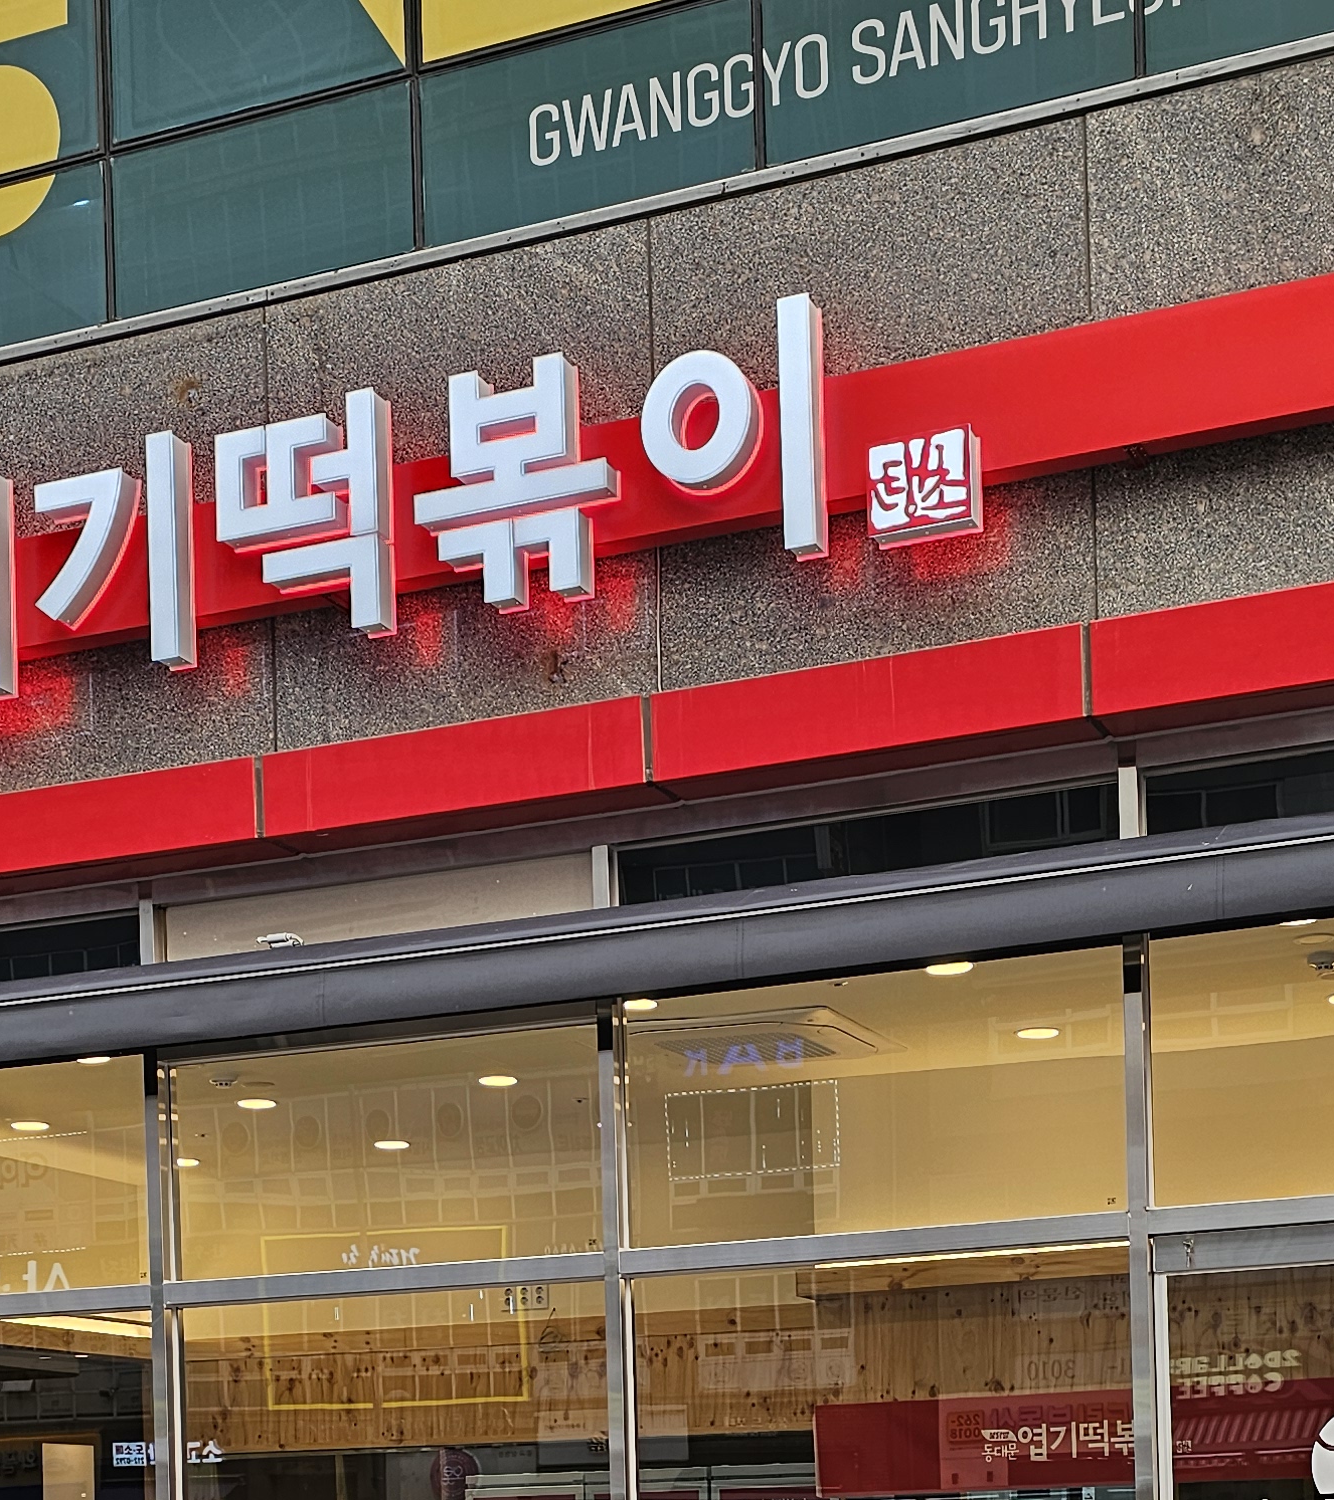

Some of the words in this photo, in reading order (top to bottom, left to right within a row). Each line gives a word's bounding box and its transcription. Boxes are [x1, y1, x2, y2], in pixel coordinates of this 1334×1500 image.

[528, 34, 829, 167] GWANGGYO
[852, 0, 1181, 85] SANGHY
[982, 1444, 1019, 1463] 동대문
[1017, 1420, 1134, 1461] 엽기떡볶
